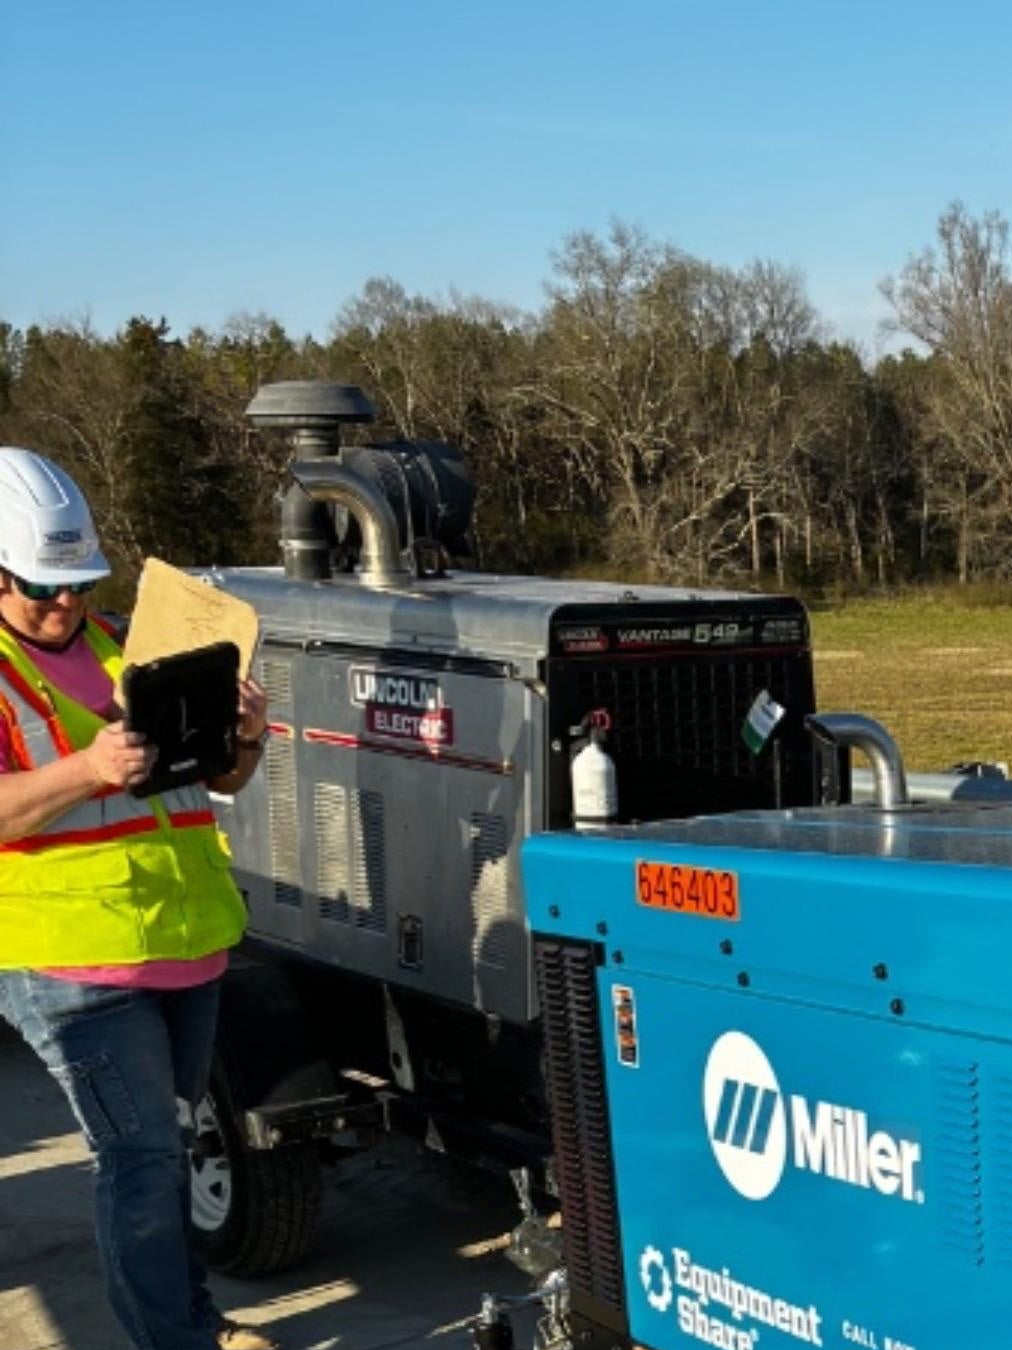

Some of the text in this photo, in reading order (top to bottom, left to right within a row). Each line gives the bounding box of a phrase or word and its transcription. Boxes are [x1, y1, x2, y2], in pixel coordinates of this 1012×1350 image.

[355, 673, 436, 711] LINCOLN
[374, 710, 448, 739] ELECTRIC
[638, 862, 737, 918] 646403
[790, 1094, 922, 1201] Miller
[672, 1247, 823, 1347] Equipment
[841, 1319, 879, 1350] CALL
